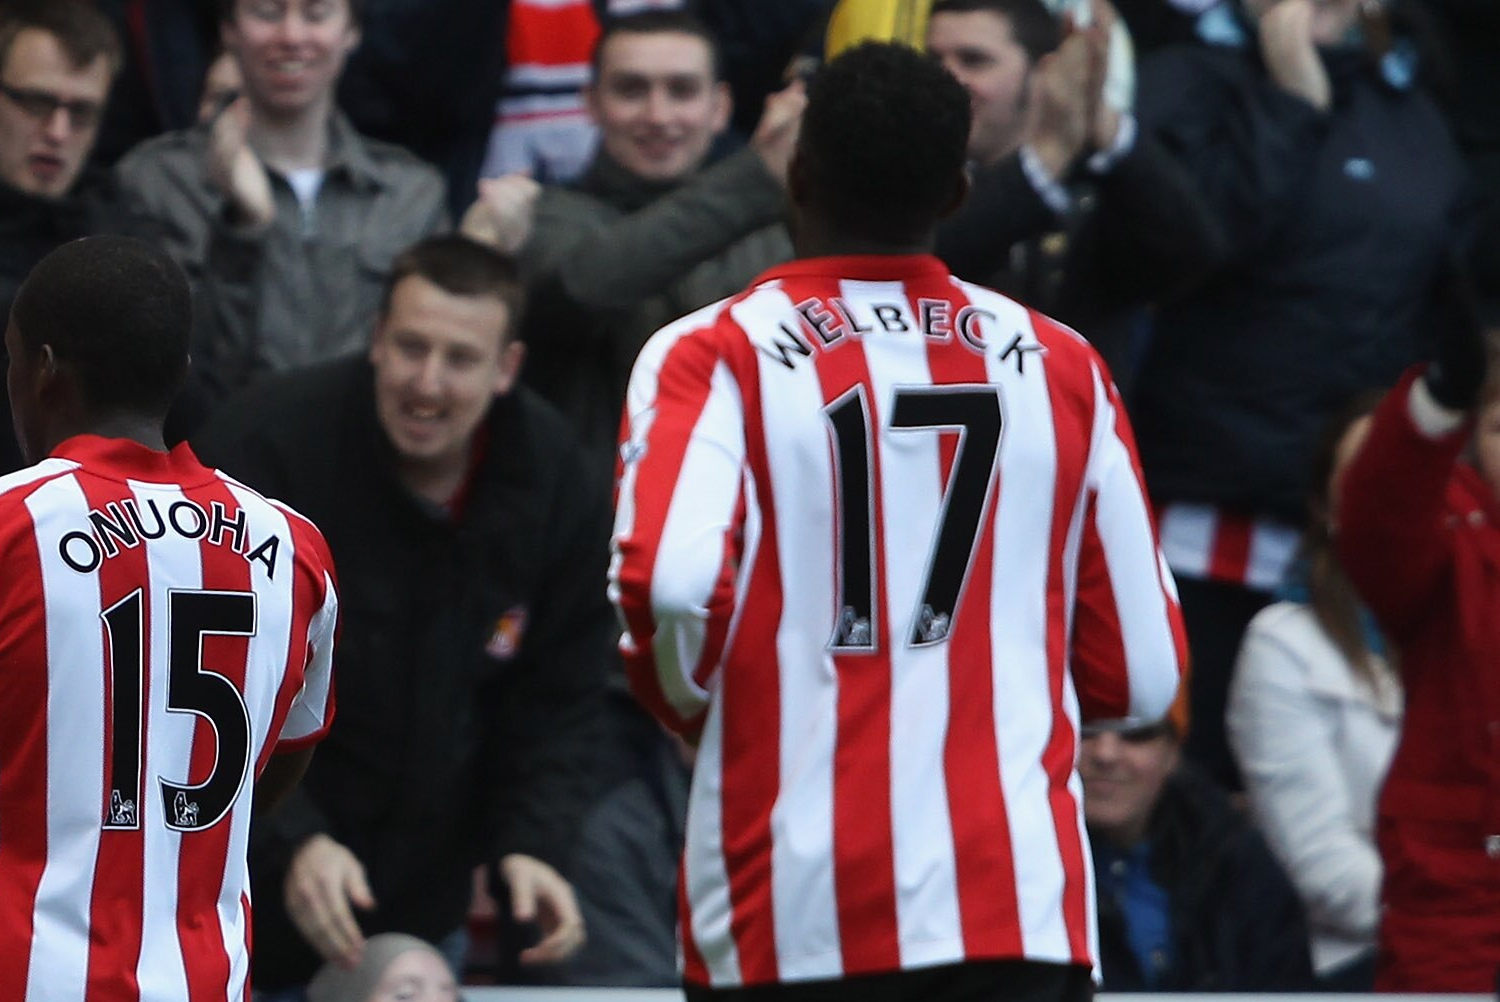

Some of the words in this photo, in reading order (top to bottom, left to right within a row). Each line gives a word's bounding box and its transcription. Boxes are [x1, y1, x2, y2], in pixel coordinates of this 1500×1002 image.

[764, 297, 1045, 375] WELBECK
[58, 498, 282, 581] ONUOHA
[822, 382, 1003, 655] 17
[100, 587, 257, 832] 15
